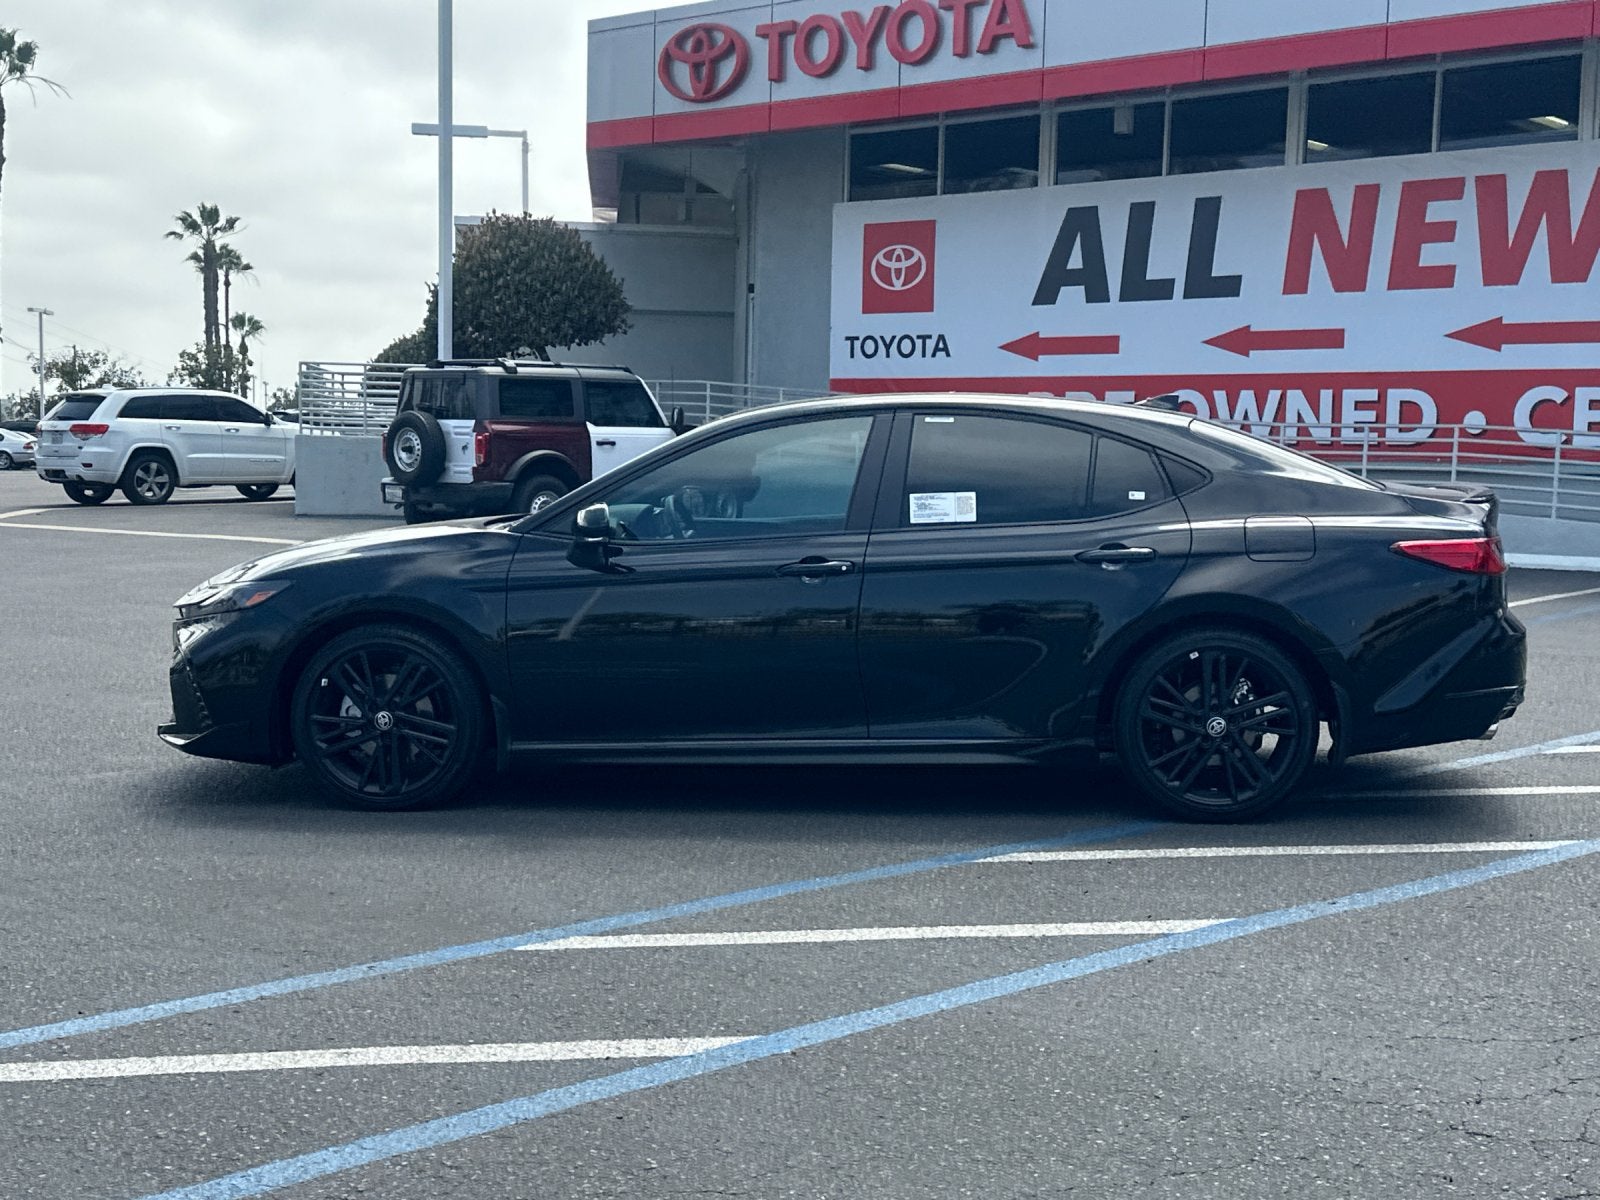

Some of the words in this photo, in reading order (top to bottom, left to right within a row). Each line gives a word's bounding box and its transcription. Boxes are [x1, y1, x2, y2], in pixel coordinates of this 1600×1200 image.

[755, 0, 1033, 82] TOYOTA
[1031, 195, 1242, 306] ALL
[1282, 167, 1600, 295] NEW
[844, 334, 951, 359] TOYOTA
